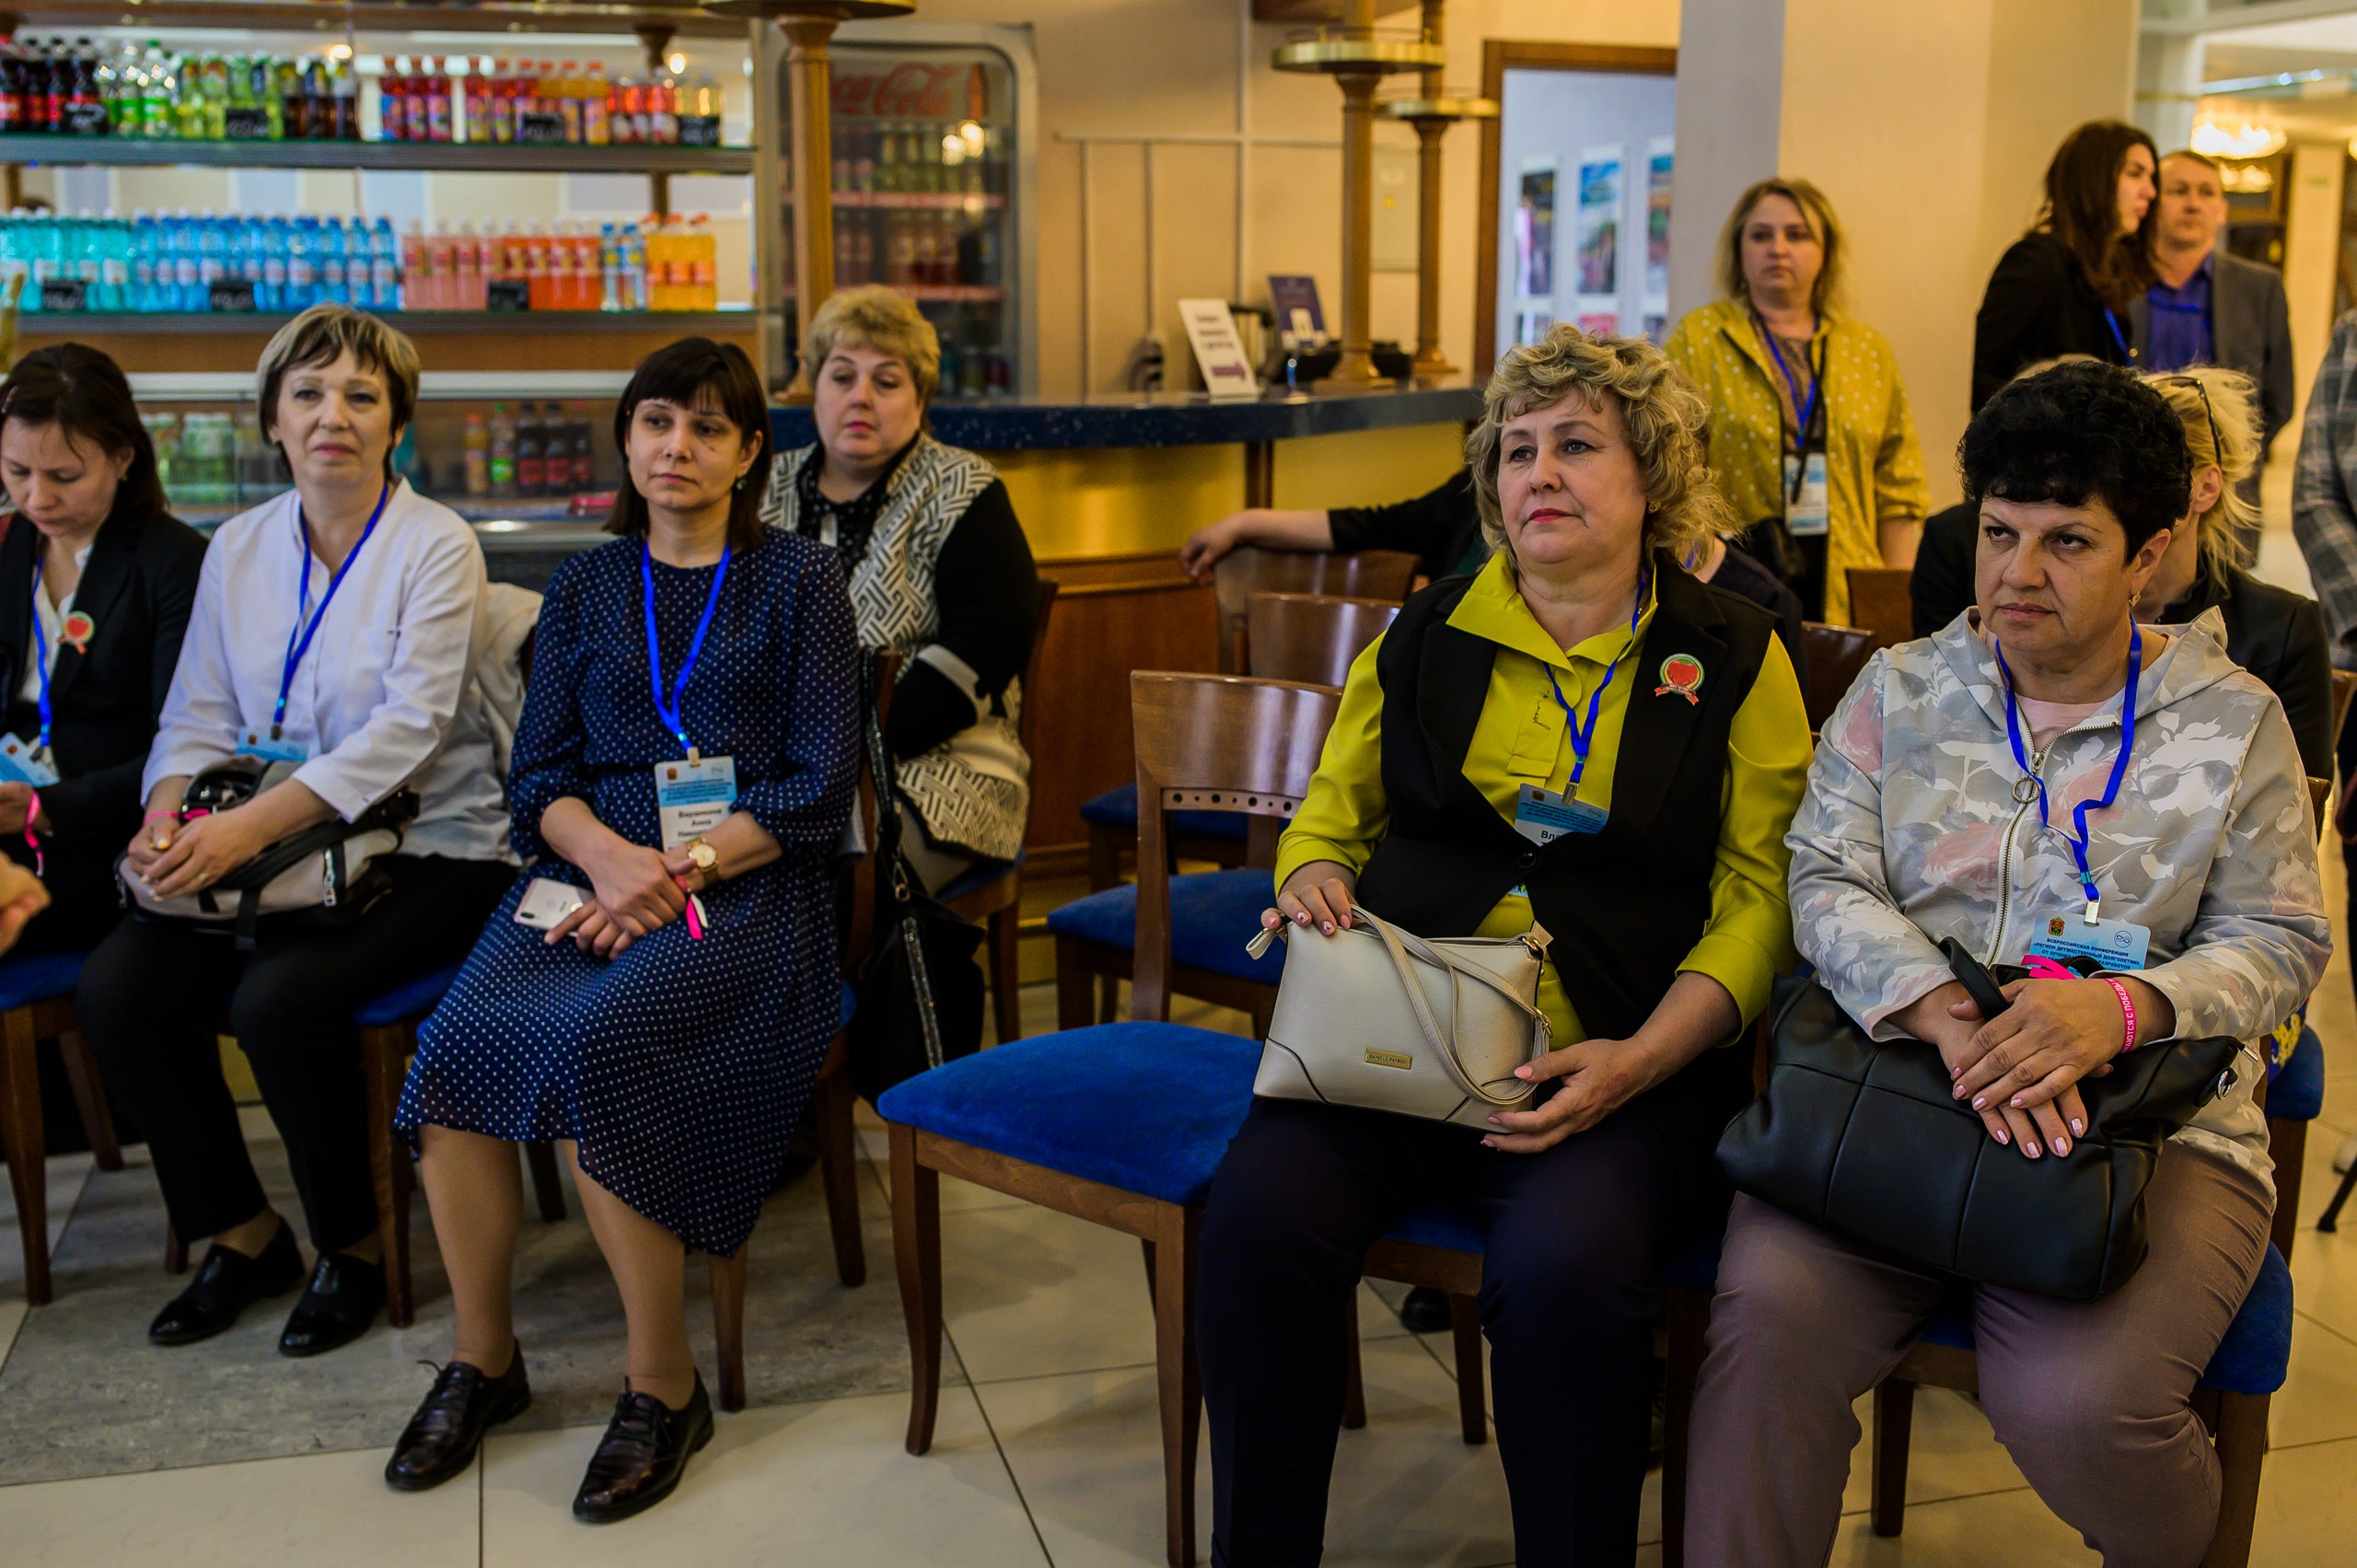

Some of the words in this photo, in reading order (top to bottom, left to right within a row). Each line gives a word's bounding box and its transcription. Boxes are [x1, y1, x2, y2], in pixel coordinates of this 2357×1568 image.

[2047, 938, 2090, 949] ВСЕРОССИЙСКАЯ
[2091, 946, 2129, 957] КОНФЕРЕНЦИЯ
[2056, 946, 2103, 958] ДРУЖЕСТВЕННЫЙ
[2113, 982, 2131, 1011] ПОБЕДЫ
